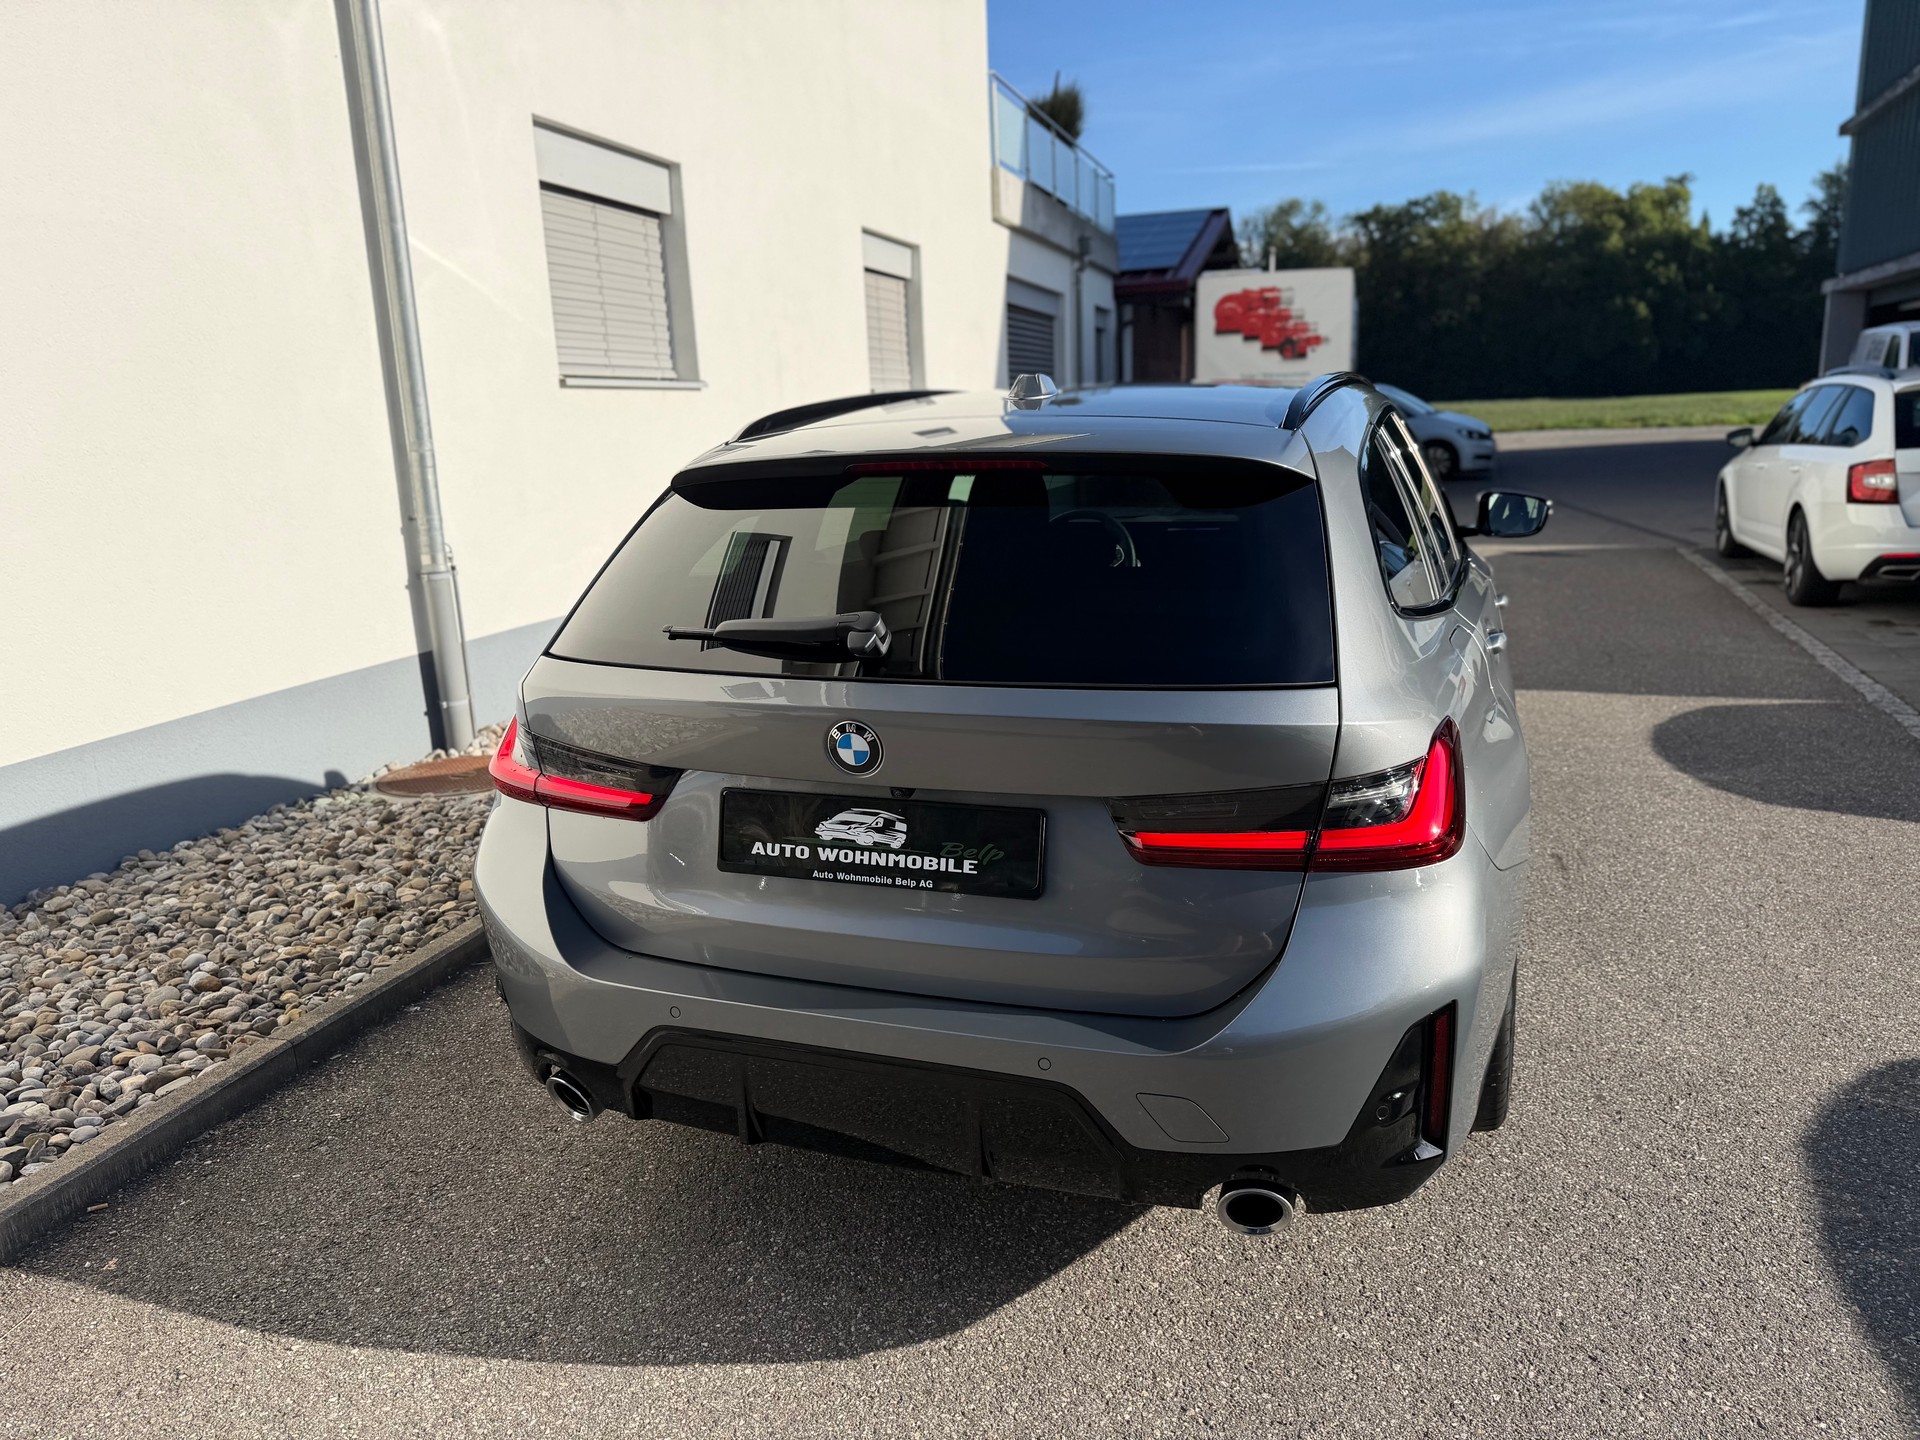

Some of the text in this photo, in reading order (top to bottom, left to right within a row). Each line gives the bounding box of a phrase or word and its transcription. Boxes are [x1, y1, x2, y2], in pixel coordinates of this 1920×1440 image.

[831, 723, 875, 742] BMW
[751, 841, 979, 875] AUTO WOHNMOBILE
[939, 842, 1005, 866] Belp
[812, 870, 933, 889] Auto Wohnmobile Belp AG
